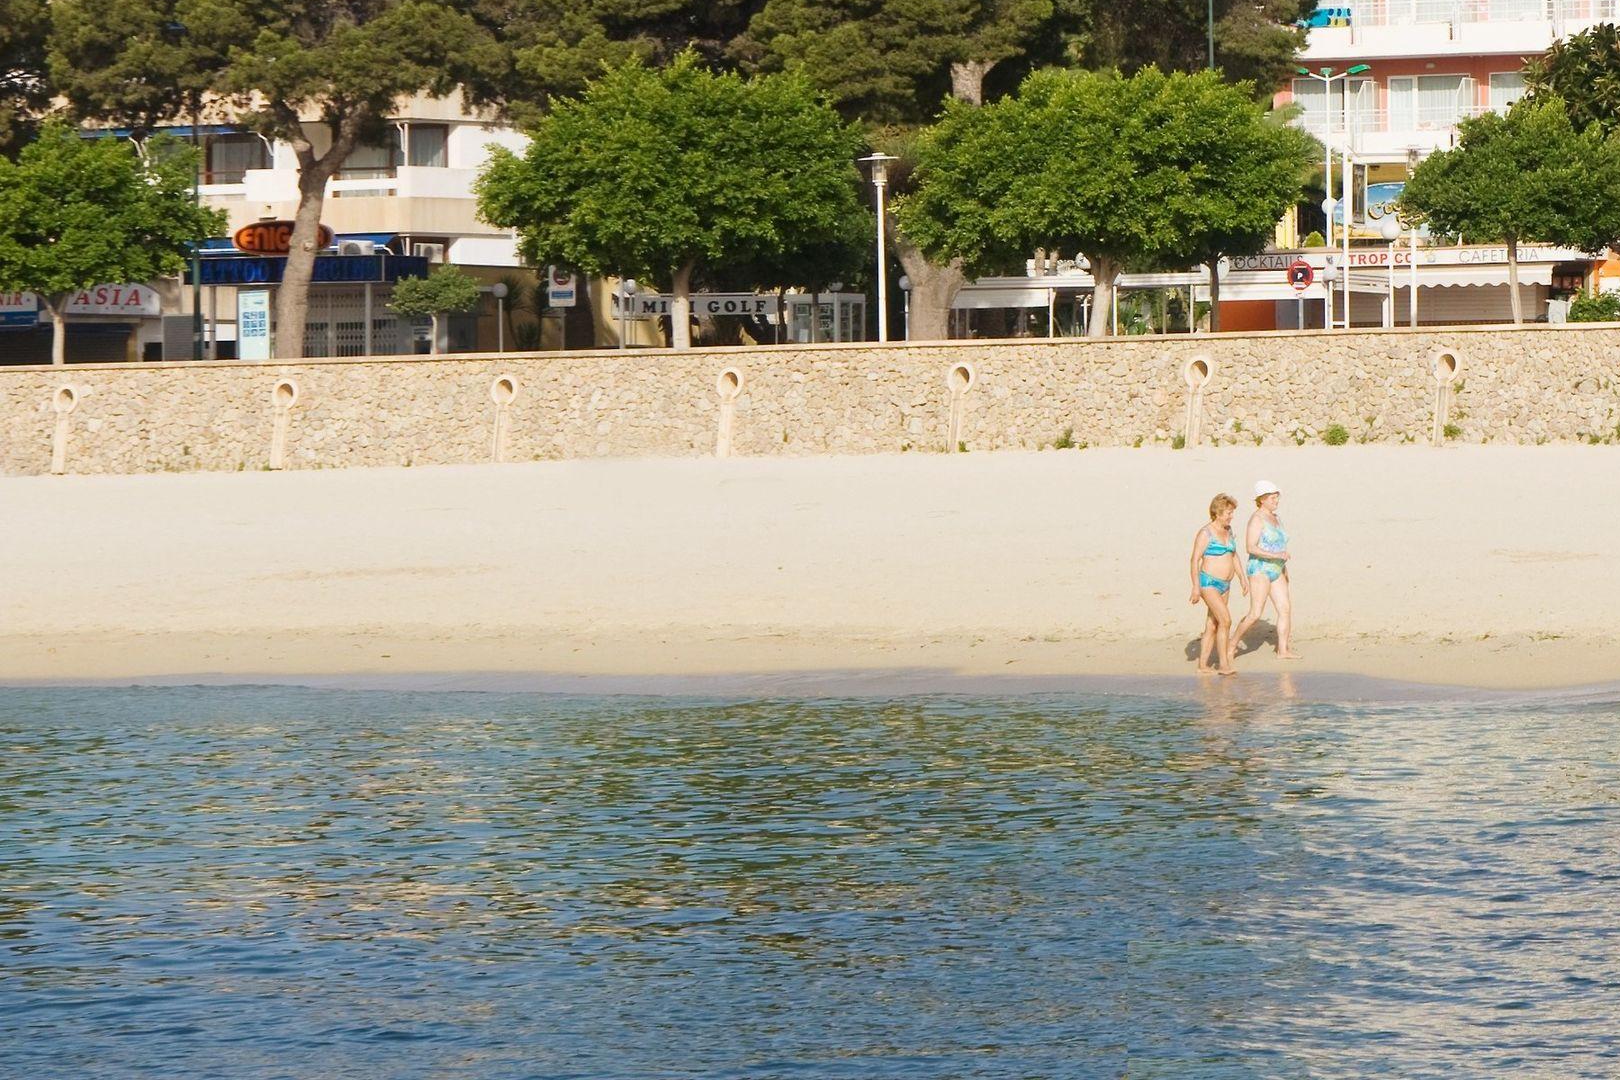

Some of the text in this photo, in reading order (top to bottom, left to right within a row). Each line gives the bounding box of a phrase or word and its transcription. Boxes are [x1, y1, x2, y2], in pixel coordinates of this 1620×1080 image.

[239, 226, 325, 250] ENIG
[1459, 248, 1538, 263] CAFETRIA
[73, 288, 141, 306] ASIA
[642, 300, 767, 314] MII GOLF
